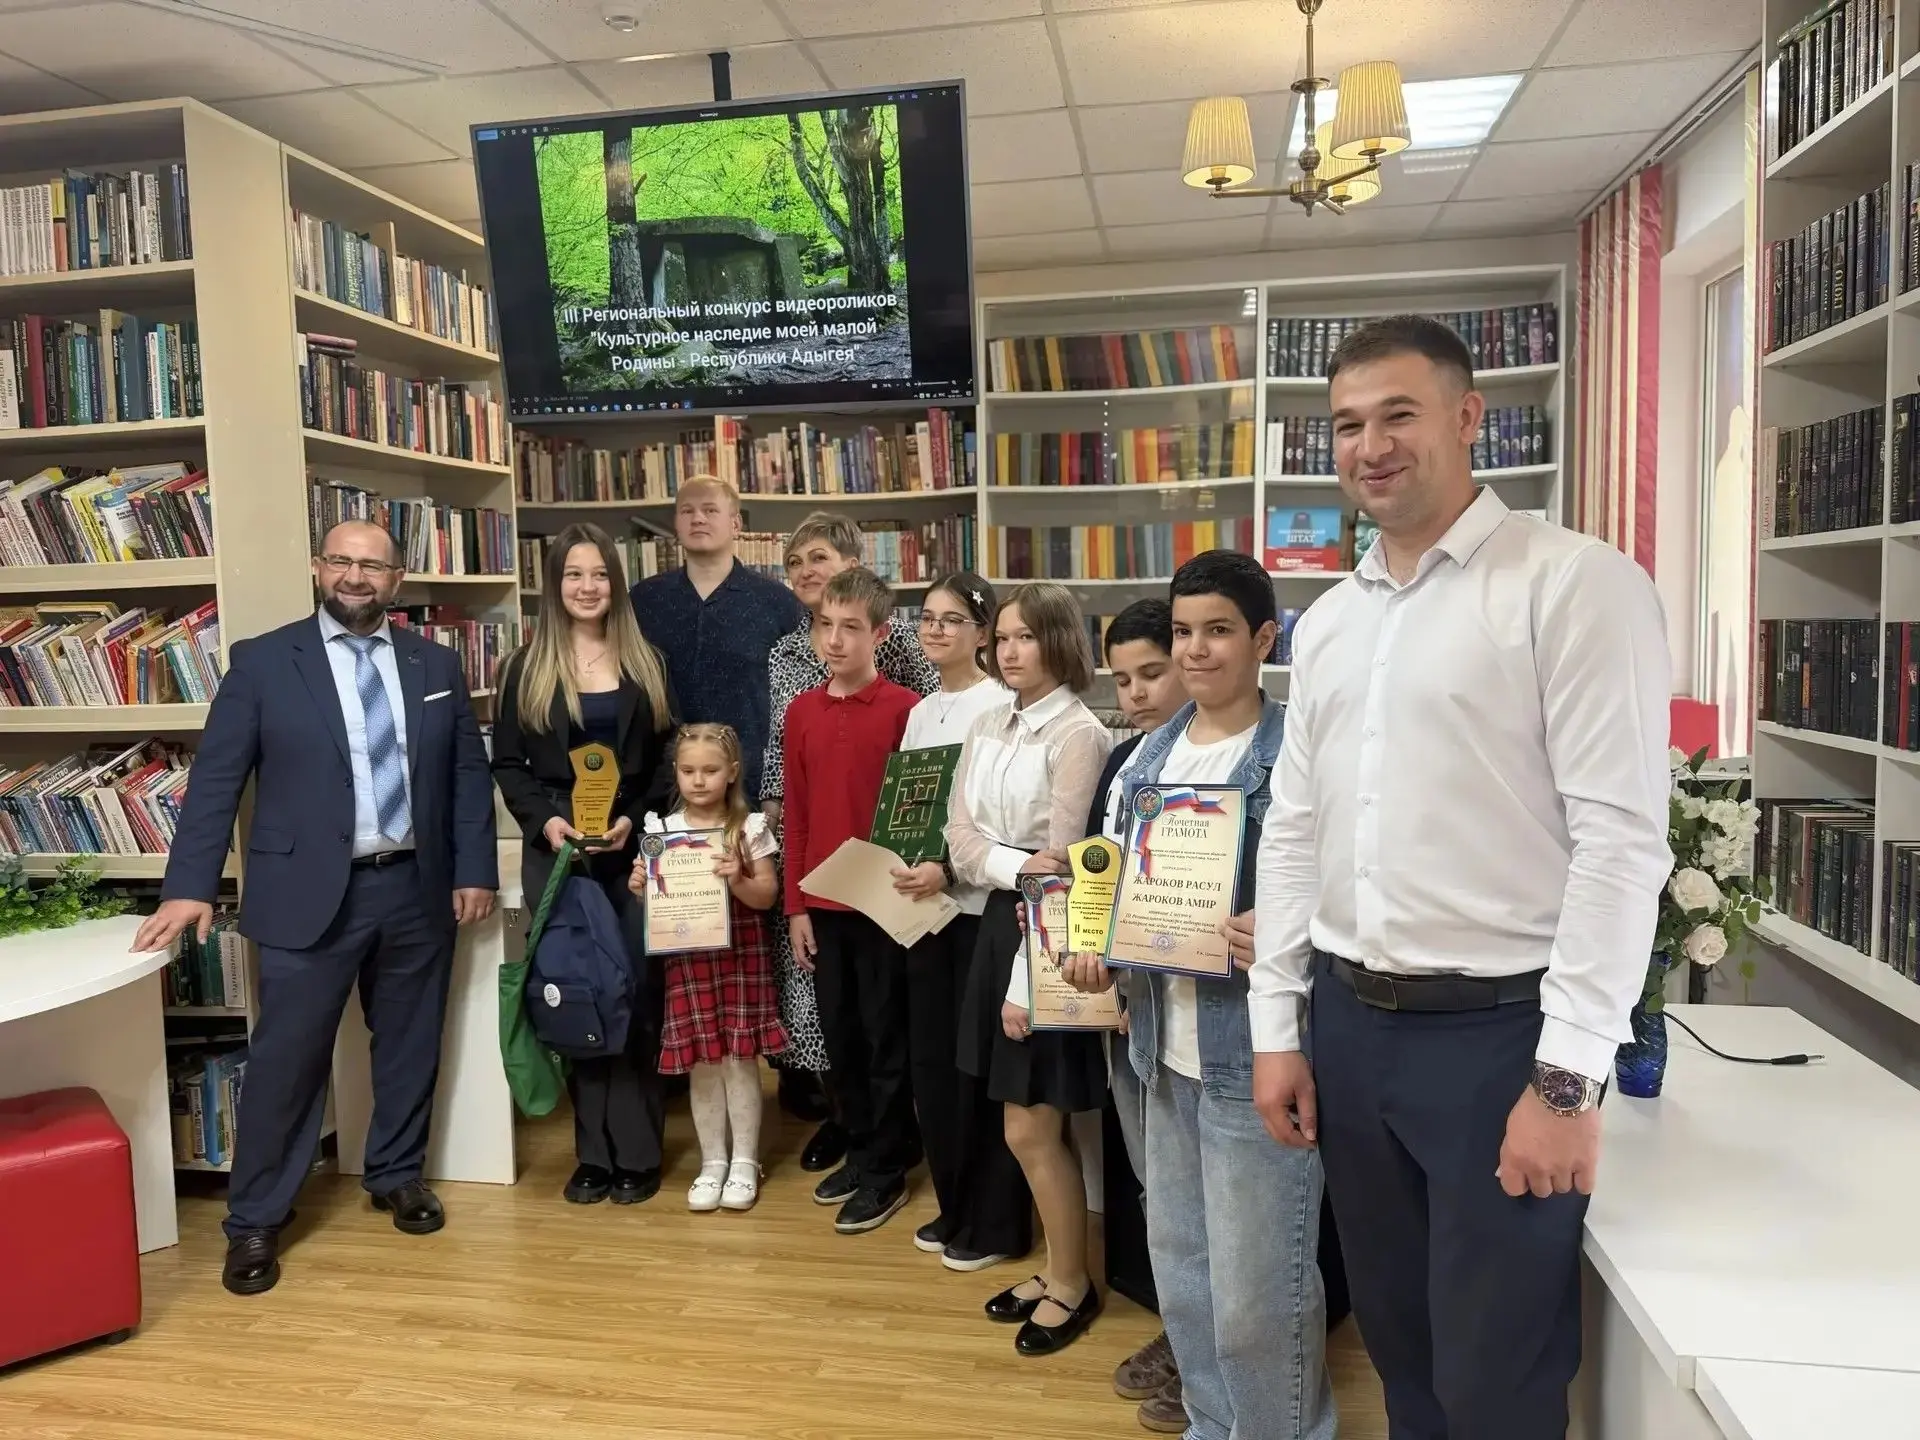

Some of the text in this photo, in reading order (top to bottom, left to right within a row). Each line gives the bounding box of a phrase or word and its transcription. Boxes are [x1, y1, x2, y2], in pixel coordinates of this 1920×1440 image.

[564, 294, 897, 324] III Региональный конкурс видеороликов
[590, 317, 877, 350] "Культурное наследие моей малой
[611, 355, 675, 372] Родины
[690, 347, 787, 371] Республики
[791, 344, 861, 366] Адыгея"
[35, 768, 69, 792] УСТРОЙСТВО
[1161, 827, 1208, 839] ГРАМОТА
[667, 858, 702, 866] ГРАМОТА
[1133, 876, 1222, 892] ЖАРОКОВ РАСУЛ
[1132, 893, 1217, 909] ЖАРОКОВ АМИР
